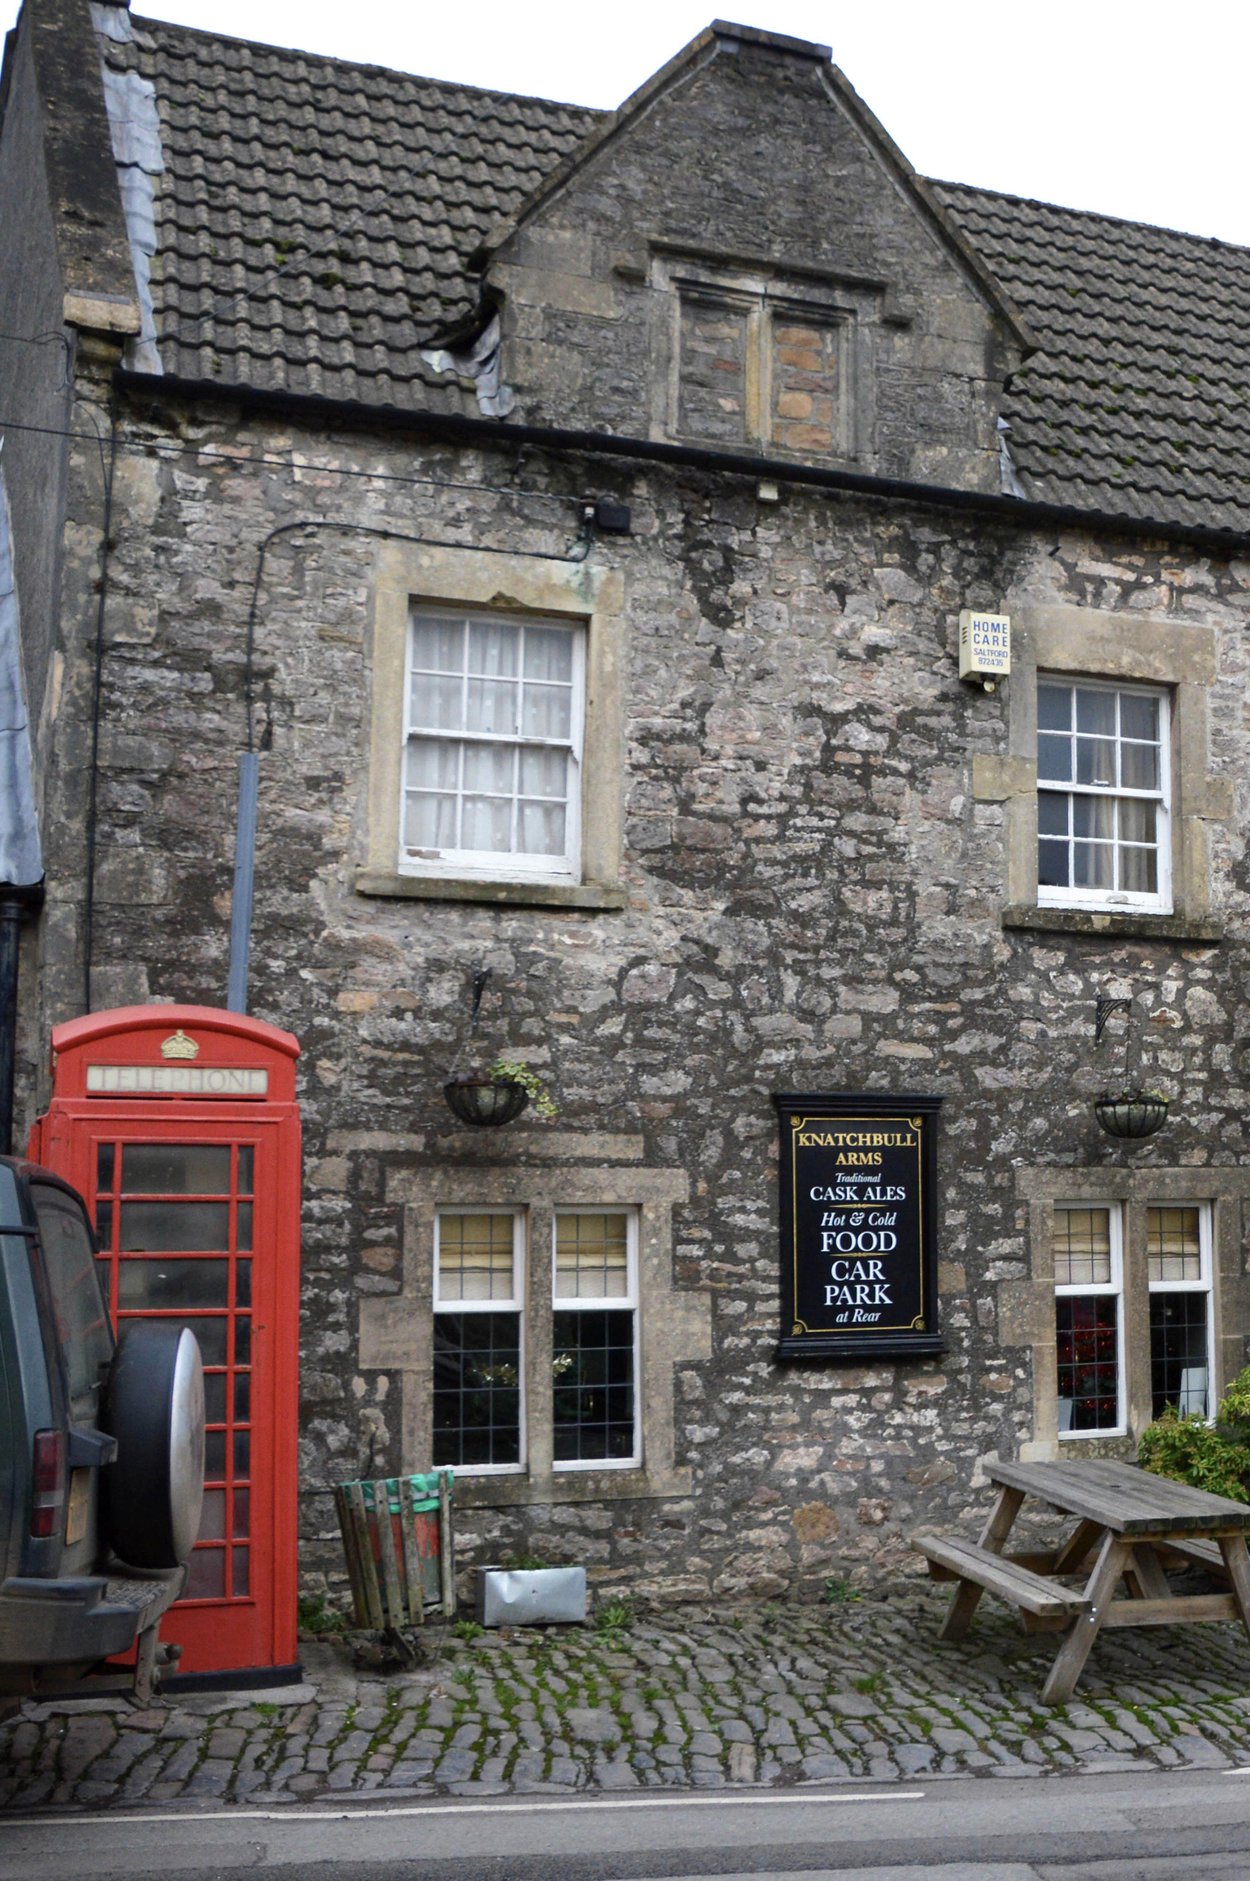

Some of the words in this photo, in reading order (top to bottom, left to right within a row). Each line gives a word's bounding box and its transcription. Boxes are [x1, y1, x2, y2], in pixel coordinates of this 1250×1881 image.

[973, 621, 1008, 634] HOME
[973, 633, 1008, 647] CARE
[974, 648, 1008, 658] SALTFORD
[95, 1067, 262, 1093] TELEPHONE
[798, 1133, 917, 1146] KNATCHBULL
[835, 1152, 883, 1166] ARMS
[835, 1172, 882, 1183] Traditional
[809, 1186, 859, 1201] CASK
[863, 1186, 906, 1201] ALES
[820, 1212, 846, 1227] Hot
[849, 1211, 865, 1227] &
[868, 1211, 897, 1227] Cold
[820, 1231, 897, 1252] FOOD
[830, 1260, 886, 1281] CAR
[823, 1284, 893, 1306] PARK
[835, 1311, 849, 1323] at
[851, 1308, 881, 1323] Rear
